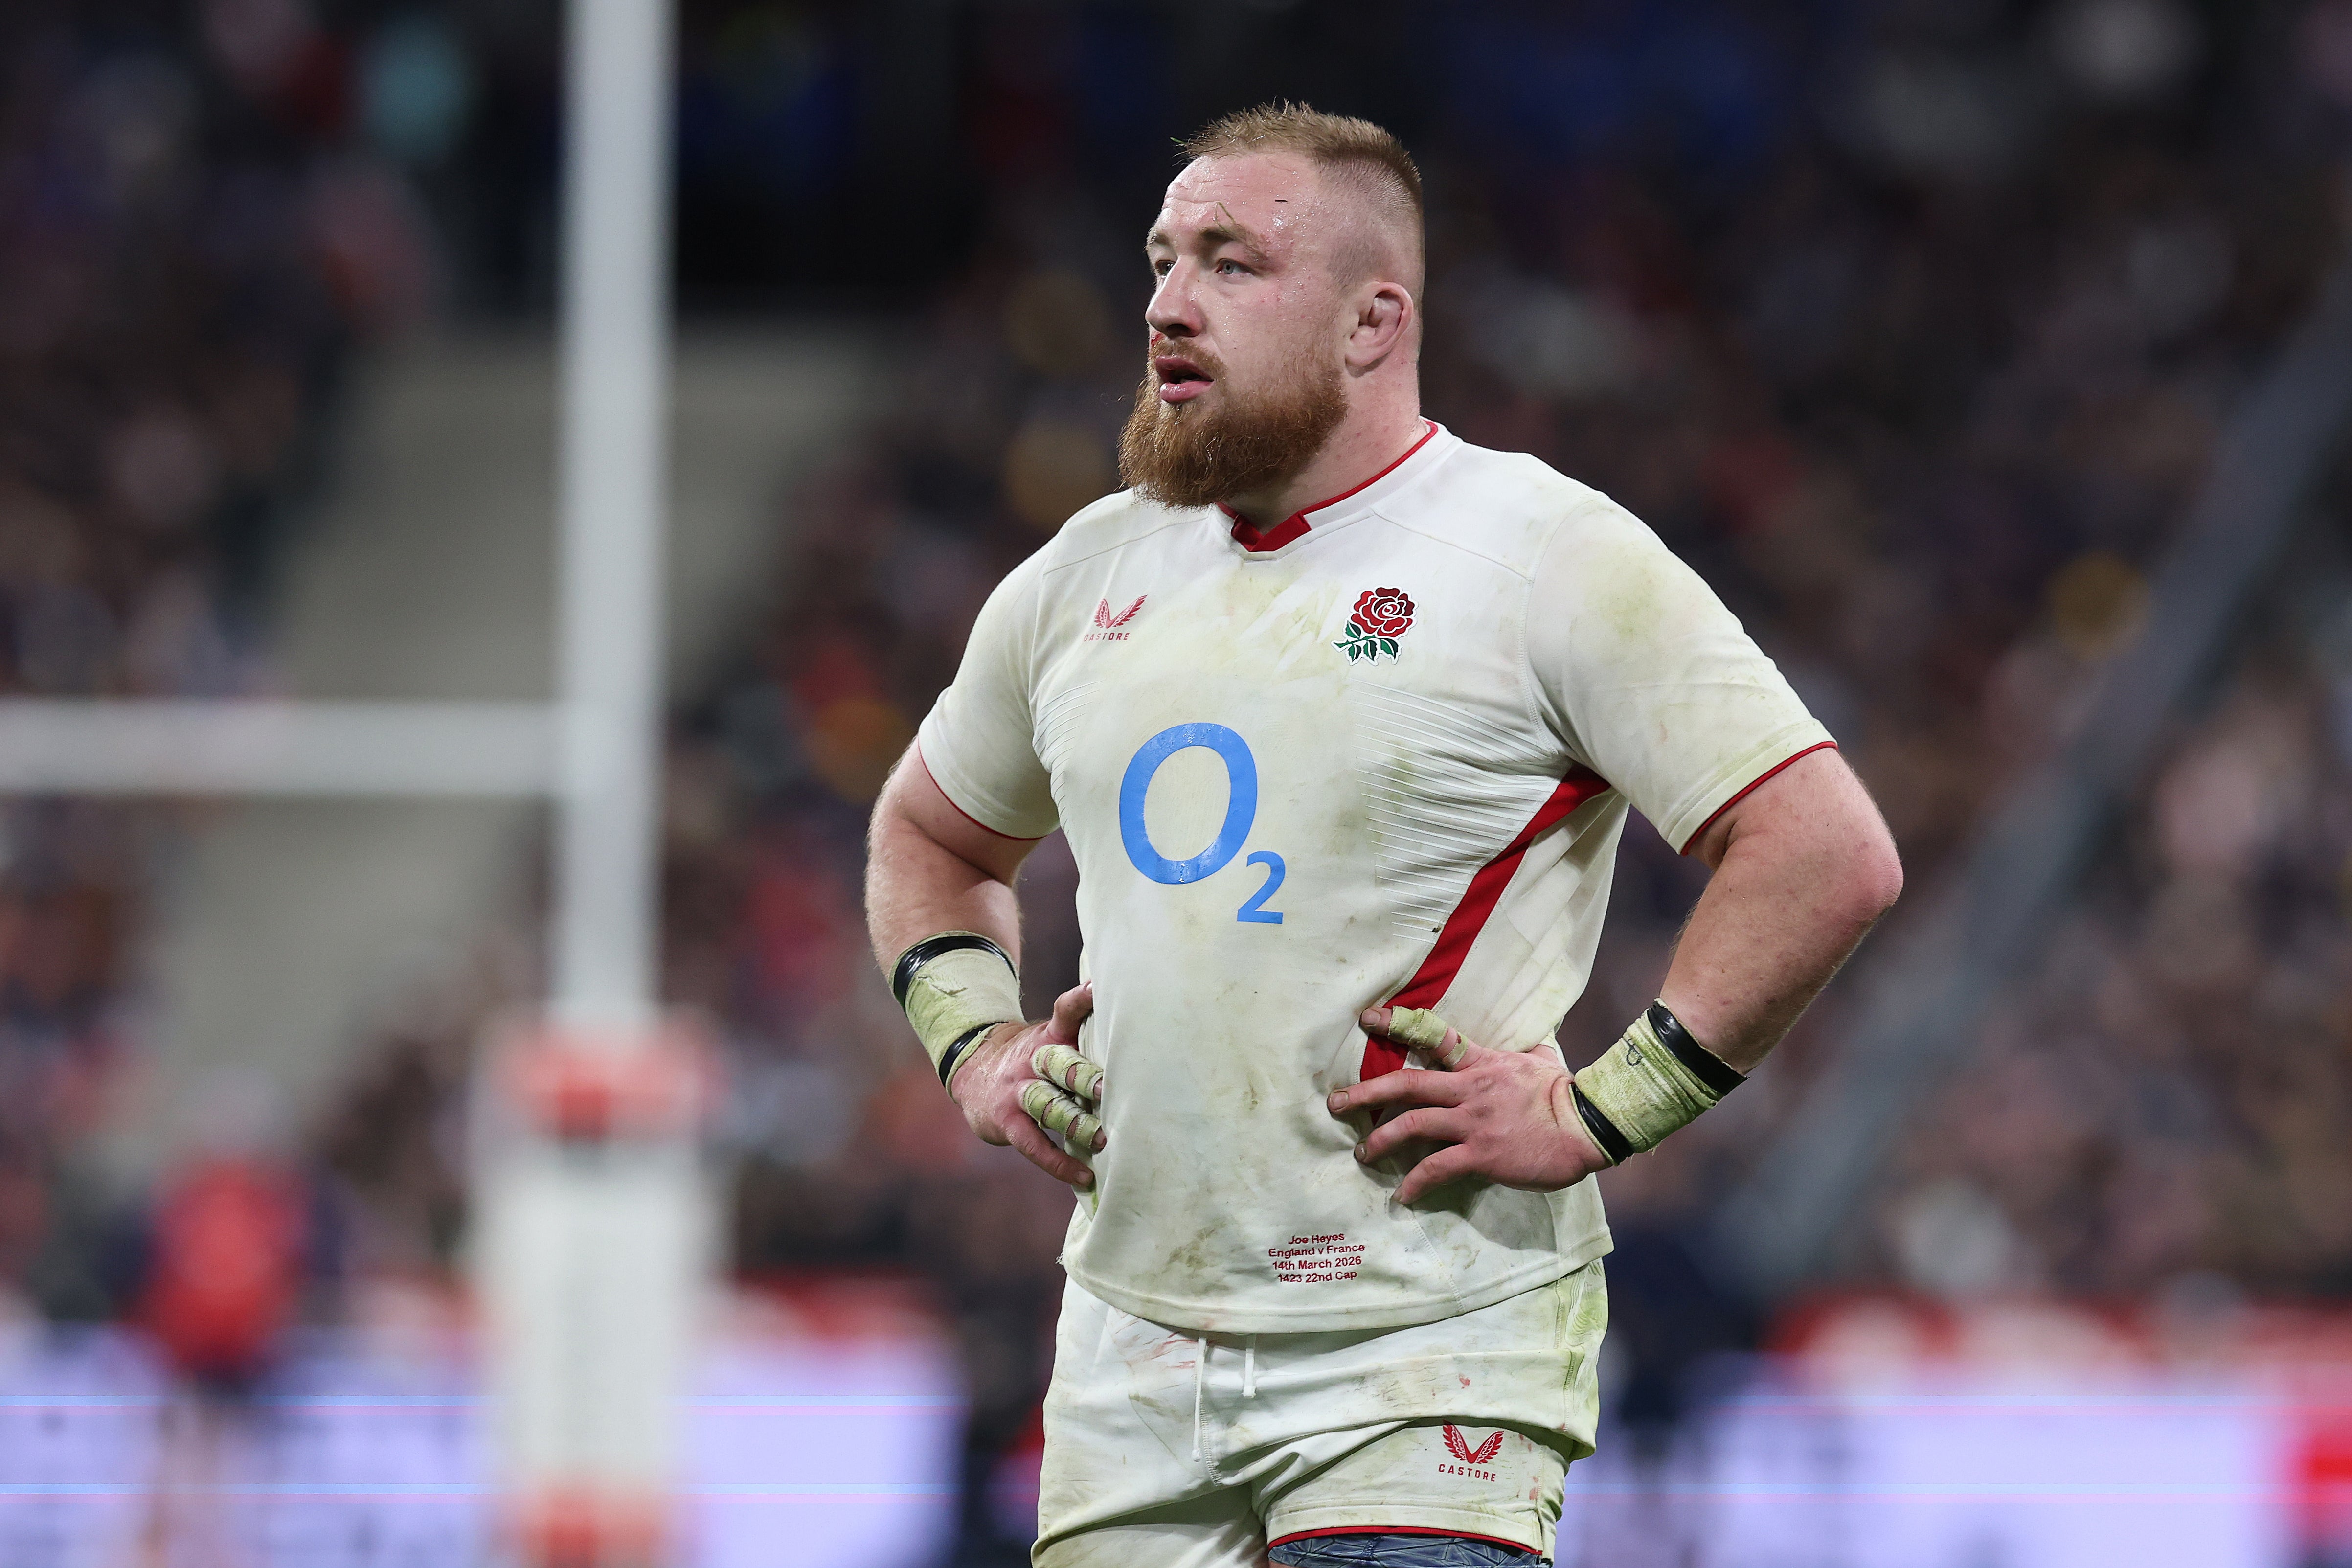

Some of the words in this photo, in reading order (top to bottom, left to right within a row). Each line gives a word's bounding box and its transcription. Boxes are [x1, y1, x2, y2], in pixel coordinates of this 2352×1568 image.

[1083, 632, 1130, 642] CASTORE
[1119, 722, 1286, 924] O2
[1288, 1235, 1308, 1245] Joe
[1311, 1233, 1345, 1244] Heyes
[1268, 1248, 1314, 1259] England
[1327, 1245, 1365, 1254] France
[1272, 1260, 1295, 1270] 14th
[1298, 1259, 1332, 1270] March
[1335, 1256, 1361, 1267] 2026
[1277, 1273, 1302, 1282] 1423
[1305, 1273, 1332, 1283] 22nd
[1335, 1271, 1357, 1280] Cap
[1438, 1464, 1496, 1482] CASTORE
